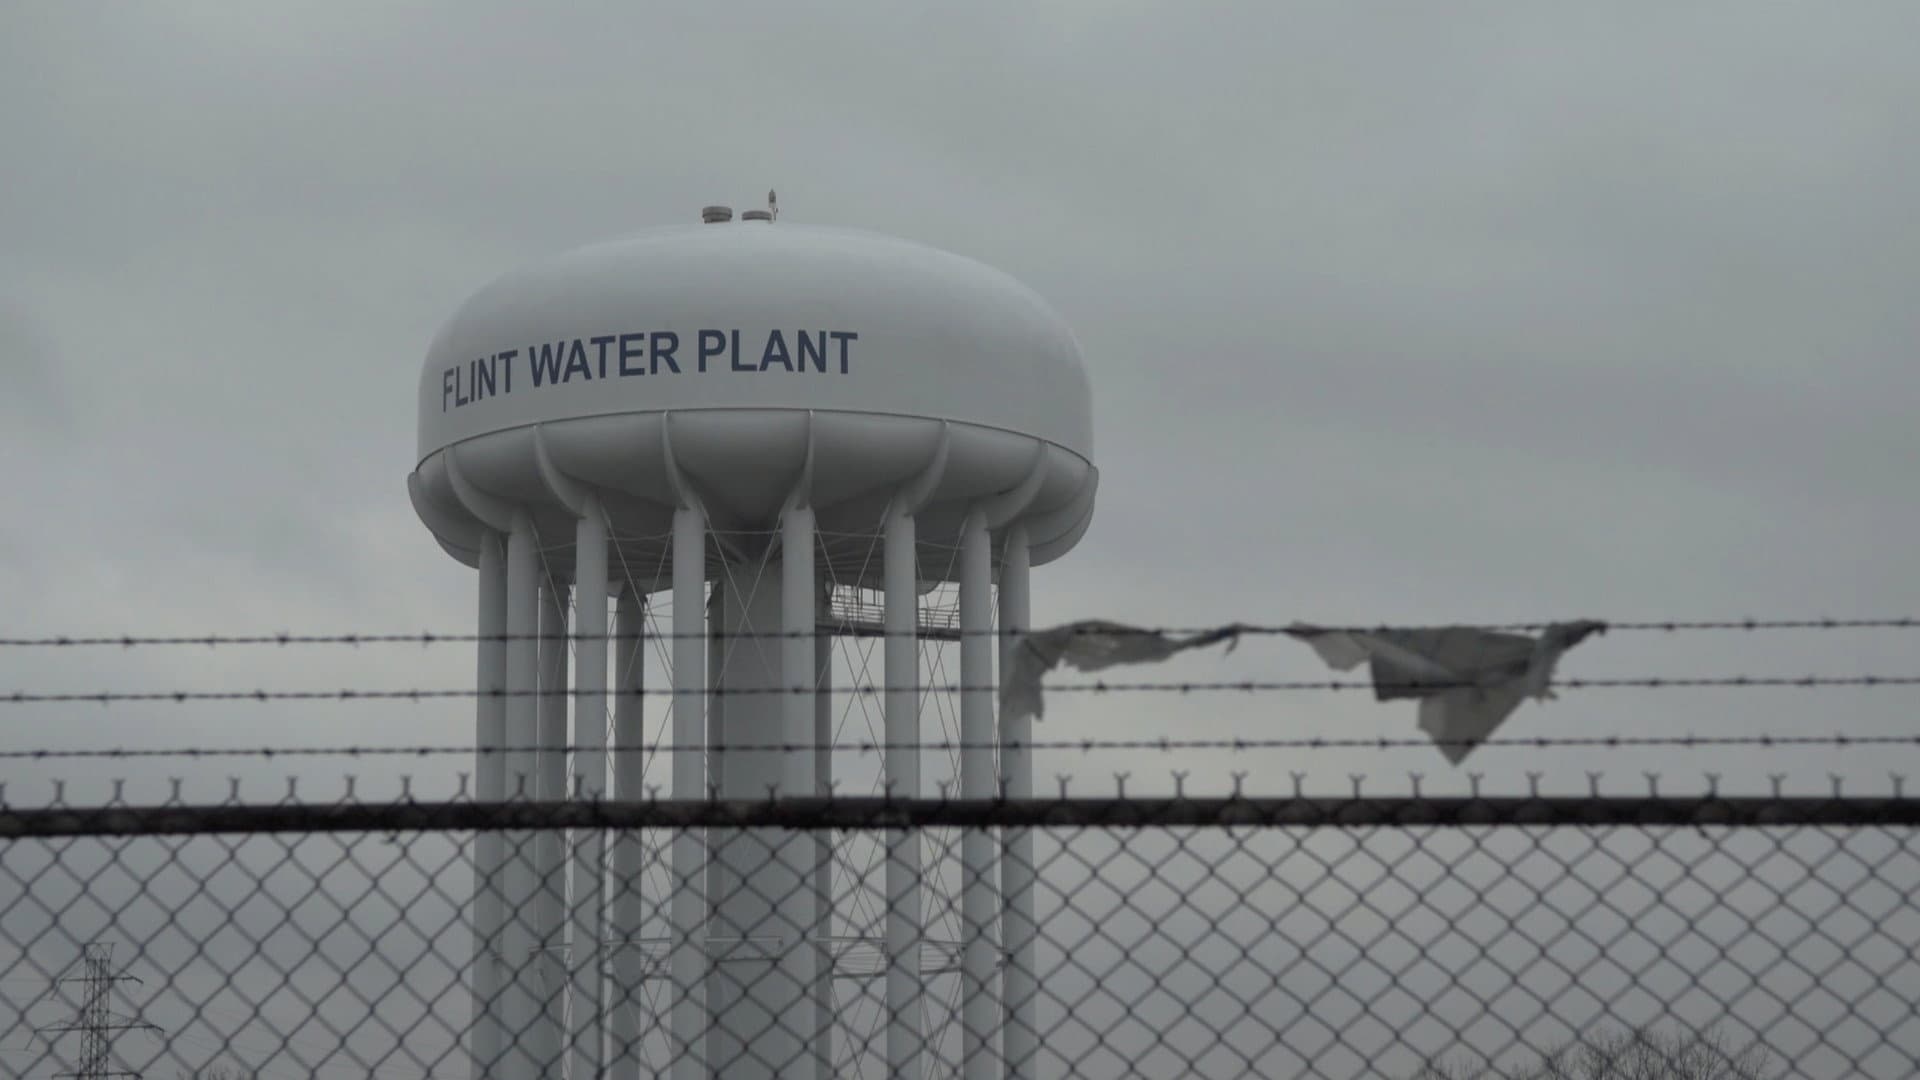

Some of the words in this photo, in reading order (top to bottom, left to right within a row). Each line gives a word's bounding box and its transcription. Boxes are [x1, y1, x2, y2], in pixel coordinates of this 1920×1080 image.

[443, 350, 518, 413] FLINT
[529, 331, 681, 388] WATER
[698, 329, 858, 375] PLANT
